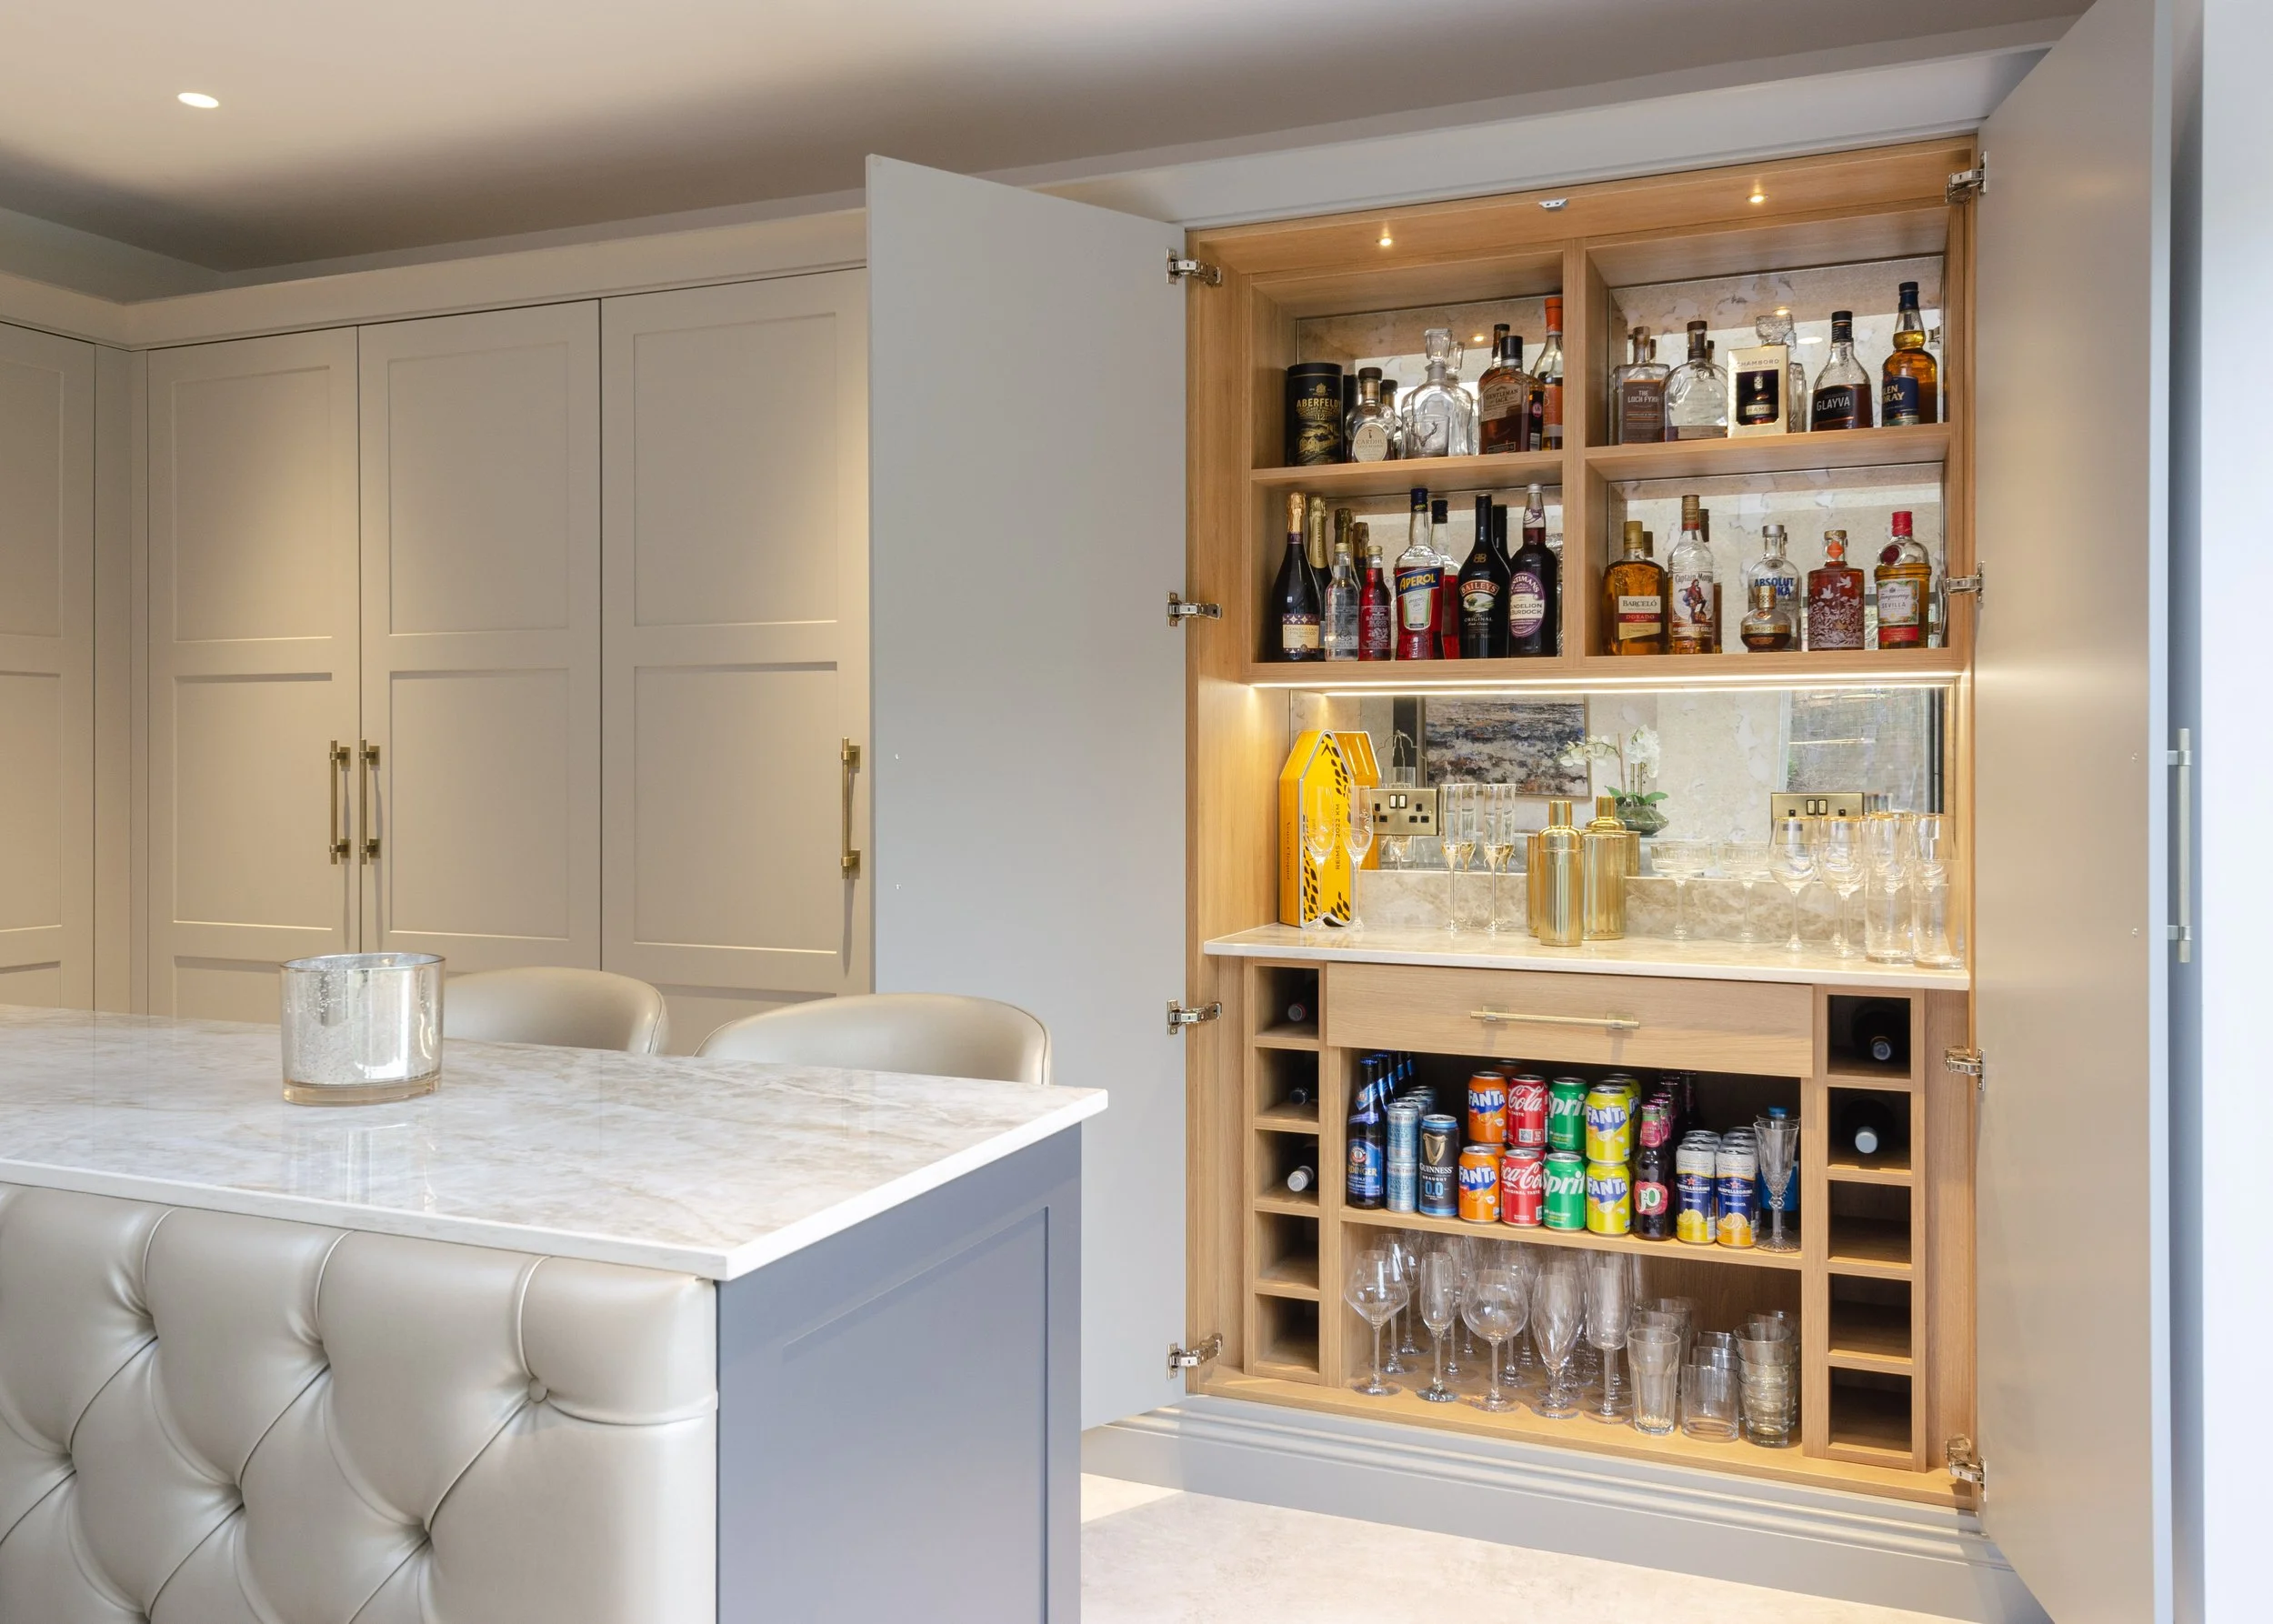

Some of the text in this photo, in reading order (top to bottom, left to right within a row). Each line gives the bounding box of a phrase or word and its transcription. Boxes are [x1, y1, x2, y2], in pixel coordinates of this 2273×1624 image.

[1486, 388, 1518, 400] GENTLEMAN
[1817, 396, 1850, 411] GLAYVA
[1400, 574, 1436, 591] APEROL
[1461, 583, 1497, 593] BAILEYS
[1754, 578, 1794, 587] ABSOLUT
[1336, 804, 1340, 816] KM
[1468, 1089, 1506, 1107] FANTA
[1587, 1106, 1627, 1125] FANTA
[1419, 1163, 1453, 1174] GUINNESS
[1458, 1166, 1497, 1184] FANTA
[1425, 1181, 1444, 1196] 0.0
[1587, 1177, 1627, 1196] FANTA
